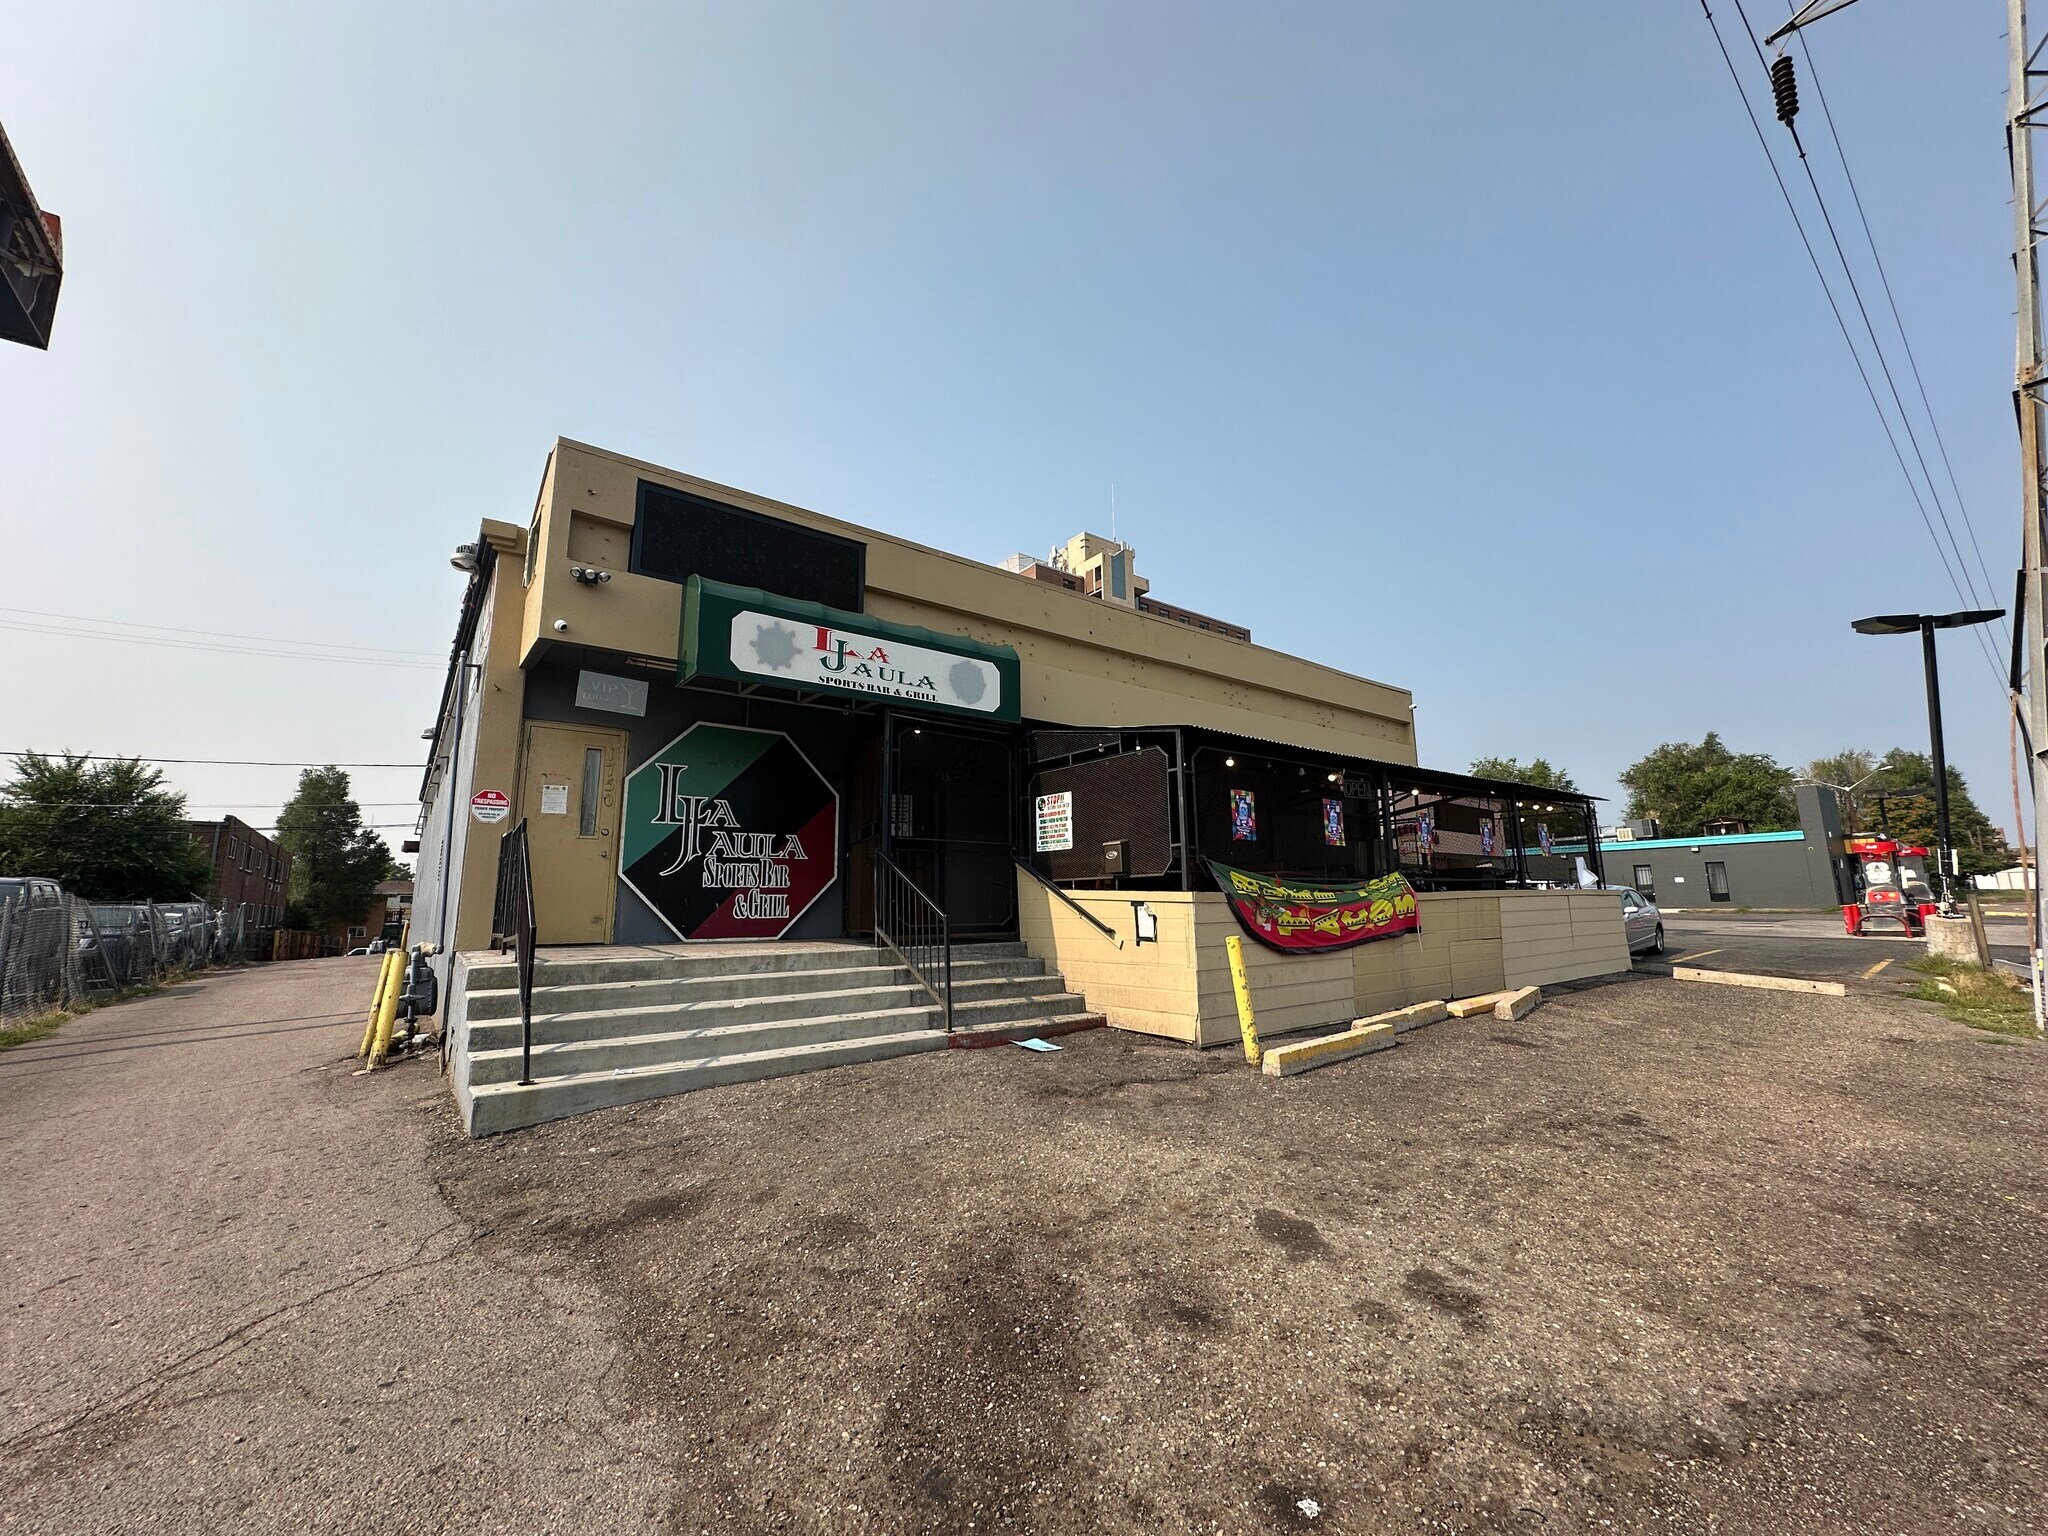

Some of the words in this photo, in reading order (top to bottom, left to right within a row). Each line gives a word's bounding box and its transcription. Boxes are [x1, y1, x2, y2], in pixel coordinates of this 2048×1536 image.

[811, 626, 891, 664] LA
[820, 639, 938, 691] JAULA
[818, 675, 864, 690] SPORTS
[866, 683, 890, 695] BAR
[893, 687, 902, 696] &
[905, 690, 938, 702] GRILL
[651, 762, 741, 828] LA
[1345, 782, 1369, 796] OPEN
[659, 796, 808, 876] JAULA
[703, 858, 759, 888] SPORTS
[760, 859, 790, 888] BAR
[733, 893, 748, 919] &
[748, 888, 790, 919] GRILL
